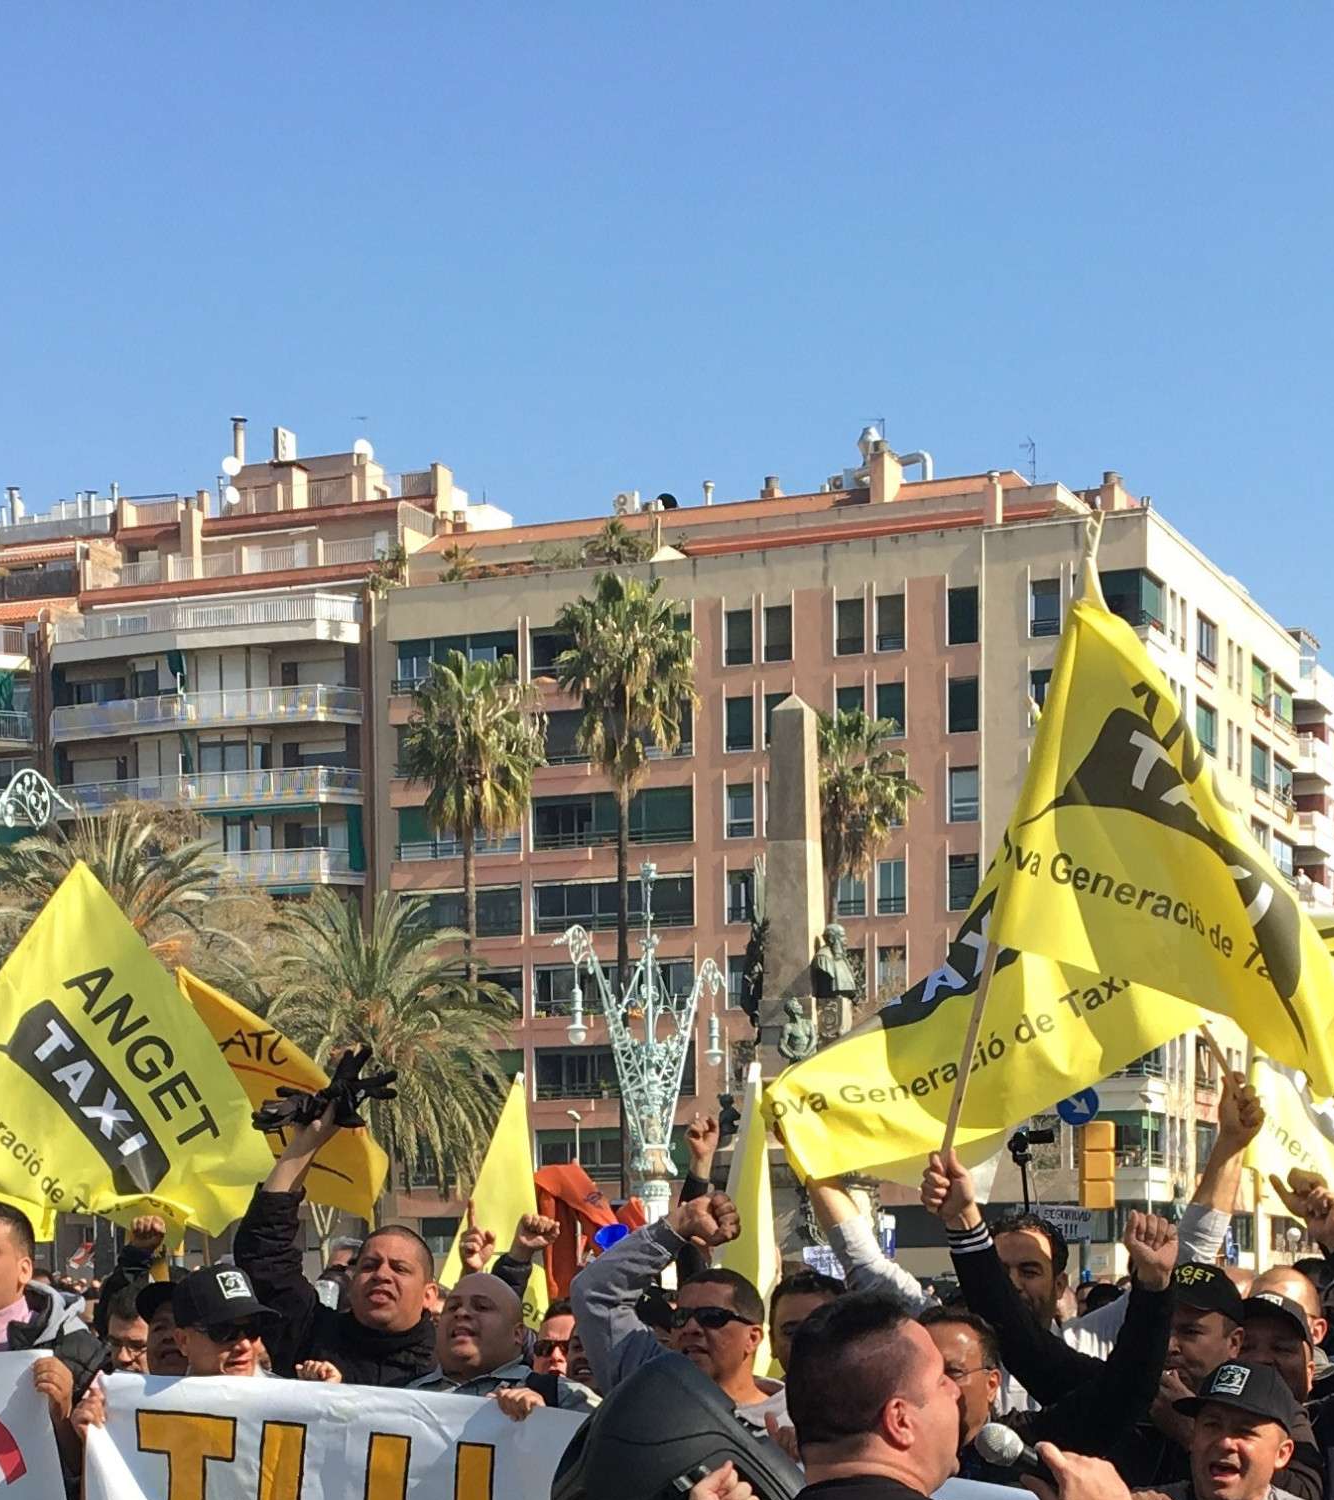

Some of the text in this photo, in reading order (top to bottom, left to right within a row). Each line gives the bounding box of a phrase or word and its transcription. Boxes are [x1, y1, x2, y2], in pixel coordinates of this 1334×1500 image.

[1051, 852, 1205, 935] Generació
[1210, 923, 1234, 958] de
[62, 966, 221, 1146] ANGET
[1014, 1011, 1055, 1045] de
[30, 1018, 149, 1157] TAXI
[40, 1173, 65, 1205] de
